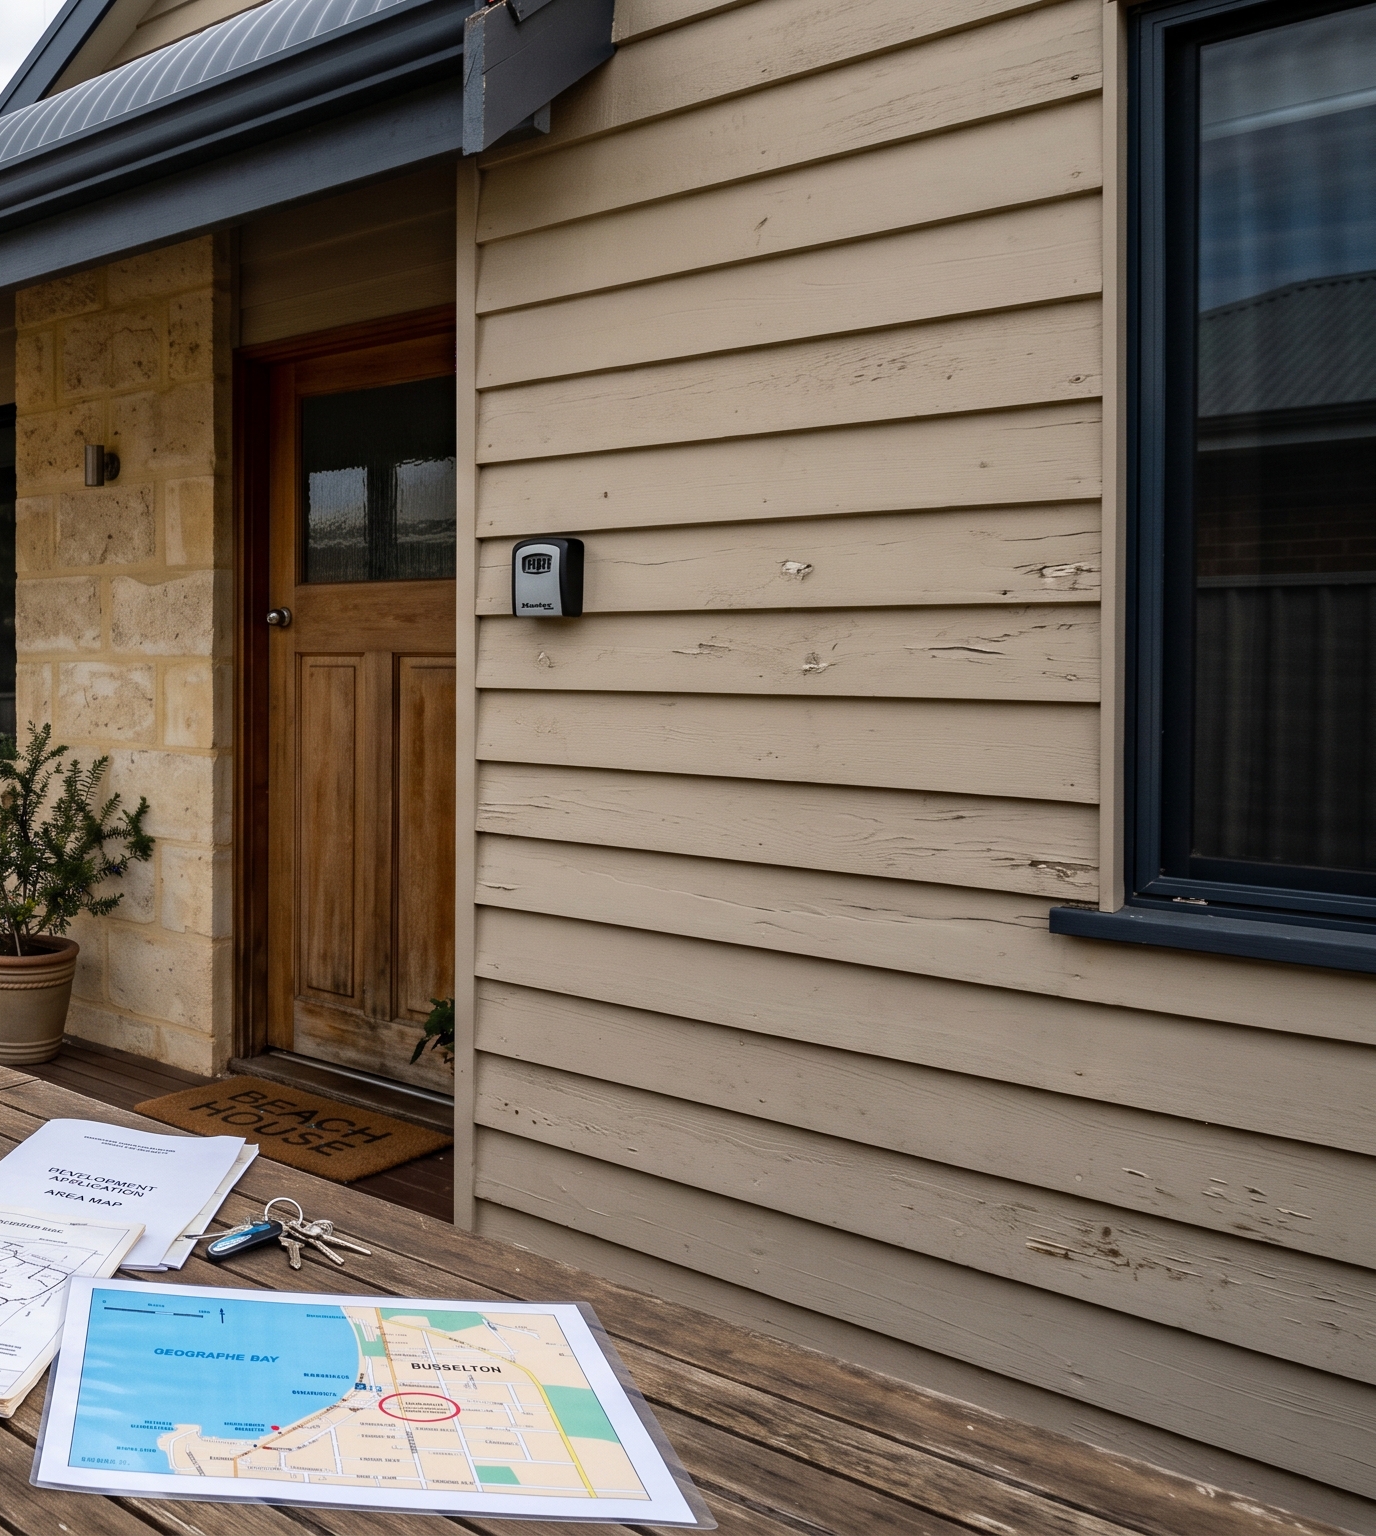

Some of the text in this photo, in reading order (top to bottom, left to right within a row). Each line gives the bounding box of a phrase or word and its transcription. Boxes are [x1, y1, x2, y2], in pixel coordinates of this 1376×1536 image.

[227, 1090, 392, 1144] BEACH
[189, 1100, 357, 1157] HOUSE
[48, 1167, 158, 1193] DEVELOPMENT
[44, 1189, 123, 1207] AREA MAP
[154, 1347, 280, 1363] GEOGRAPHE BAY
[411, 1362, 502, 1374] BUSSELTON
